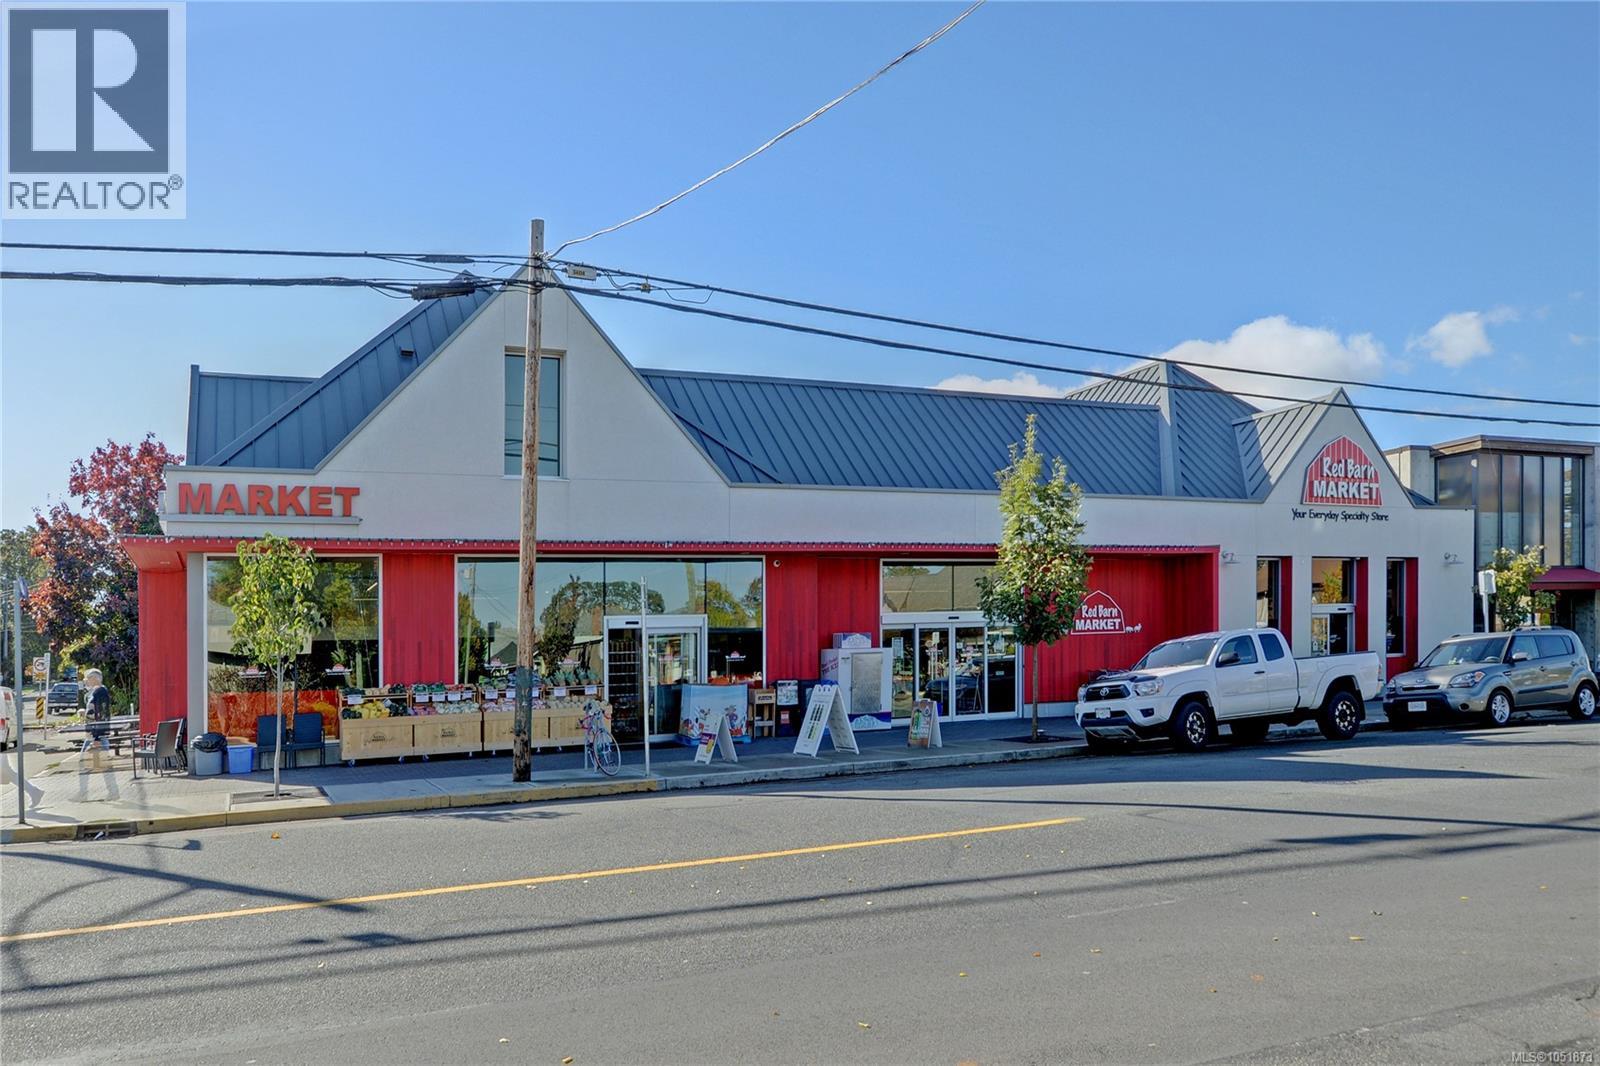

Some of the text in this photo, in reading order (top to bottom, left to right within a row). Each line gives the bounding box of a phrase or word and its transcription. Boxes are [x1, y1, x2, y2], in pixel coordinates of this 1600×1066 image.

[1323, 457, 1376, 479] Red Barn
[1313, 480, 1379, 499] MARKET
[178, 483, 361, 517] MARKET
[1291, 508, 1389, 522] Your Everyday Specialty Store
[1082, 604, 1118, 617] Red Barn
[1075, 619, 1121, 631] MARKET
